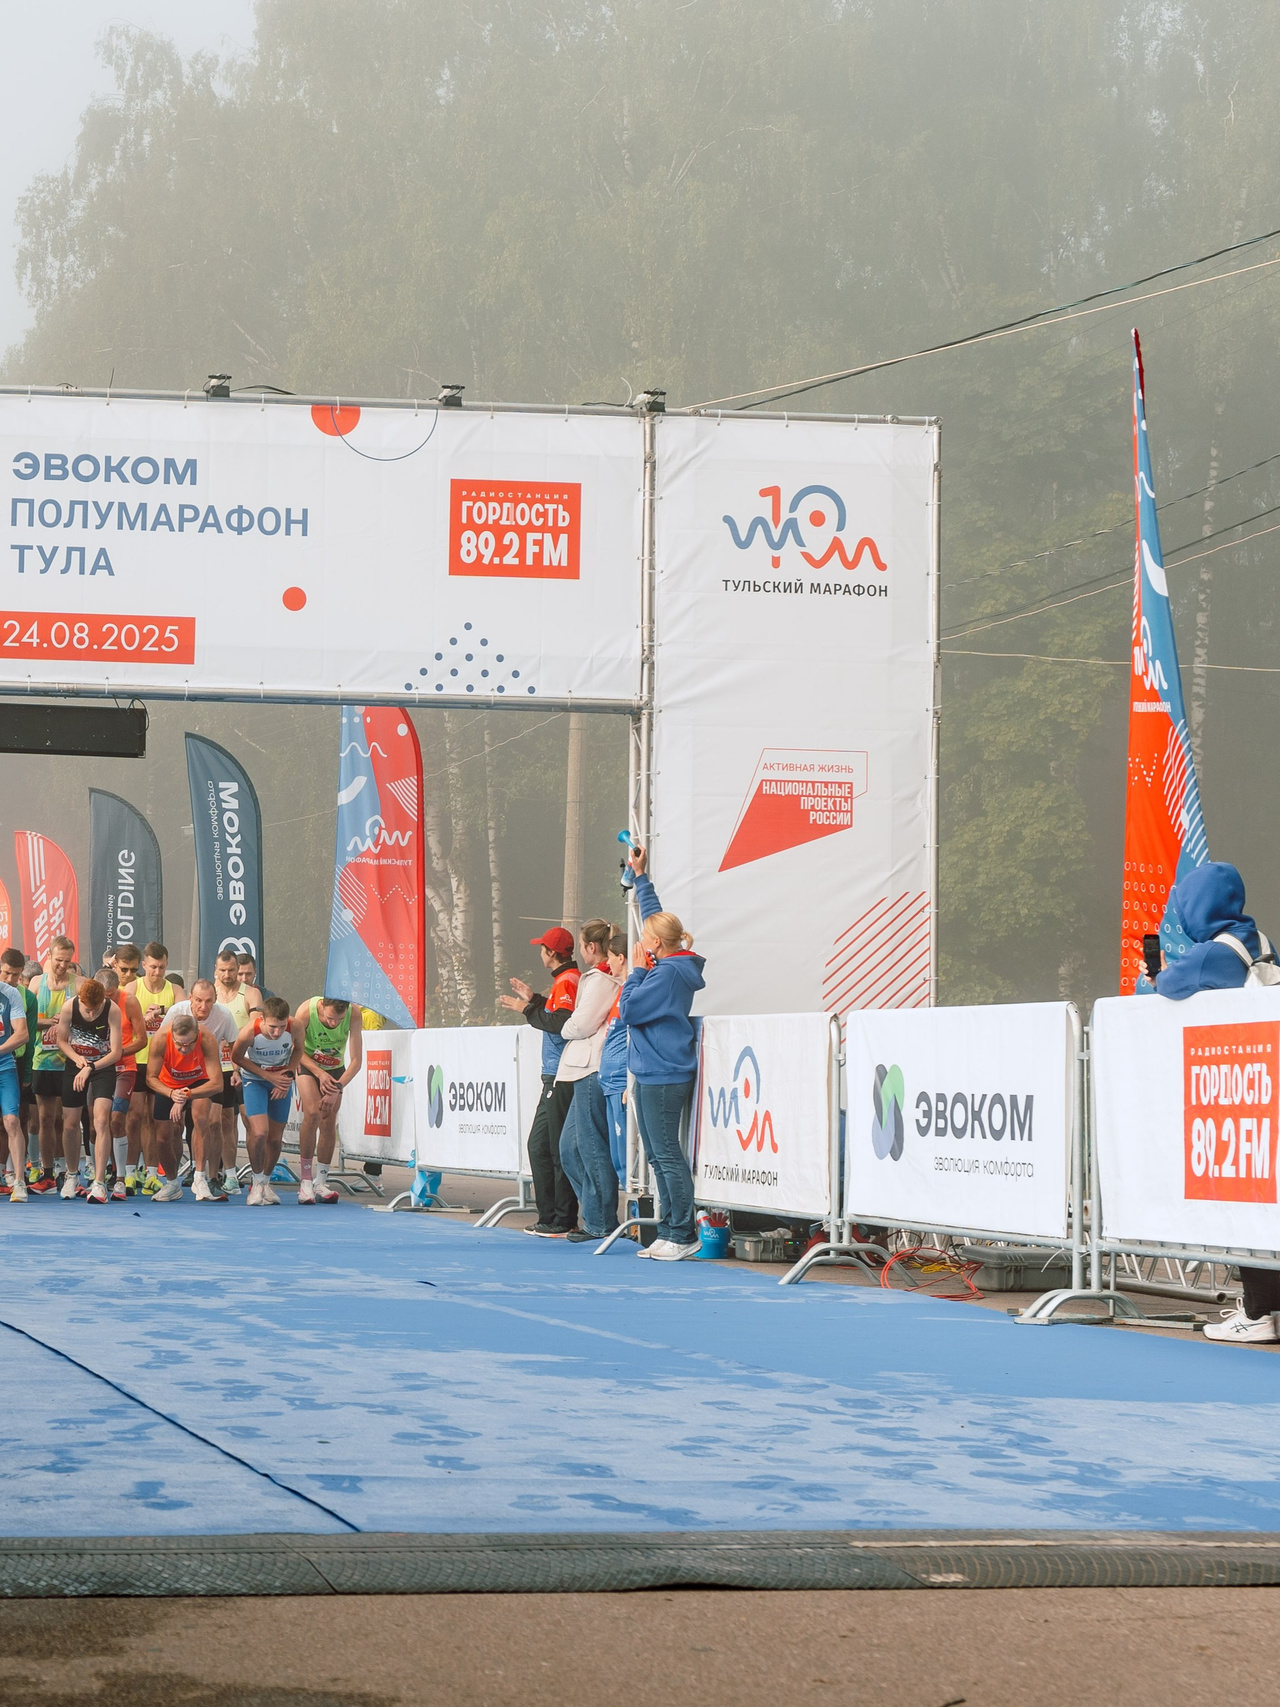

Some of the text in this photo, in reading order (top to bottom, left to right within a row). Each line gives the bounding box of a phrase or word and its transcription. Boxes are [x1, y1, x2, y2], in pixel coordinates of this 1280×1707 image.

[12, 451, 198, 486] ЭВОКОМ
[462, 490, 568, 500] РАДИОСТАНЦИЯ
[10, 497, 309, 537] ПОЛУМАРАФОН
[461, 500, 570, 527] ГОРДОСТЬ
[10, 544, 116, 577] ТУЛА
[460, 529, 568, 567] 89.2 FM
[722, 578, 888, 597] ТУЛЬСКИЙ МАРАФОН
[762, 762, 854, 774] АКТИВНАЯ ЖИЗНЬ
[762, 781, 851, 797] НАЦИОНАЛЬНЫЕ
[800, 796, 851, 811] ПРОЕКТЫ
[809, 811, 851, 825] РОССИИ
[1190, 1043, 1272, 1057] РАДИОСТАНЦИЯ
[448, 1081, 506, 1113] ЭВОКОМ
[1190, 1062, 1272, 1106] ГОРДОСТЬ
[915, 1090, 1034, 1142] ЭВОКОМ
[1191, 1117, 1270, 1178] 89.2 FM
[704, 1164, 778, 1187] ТУЛЬСКИЙ МАРАФОН
[934, 1156, 1034, 1182] эволюция комфорта
